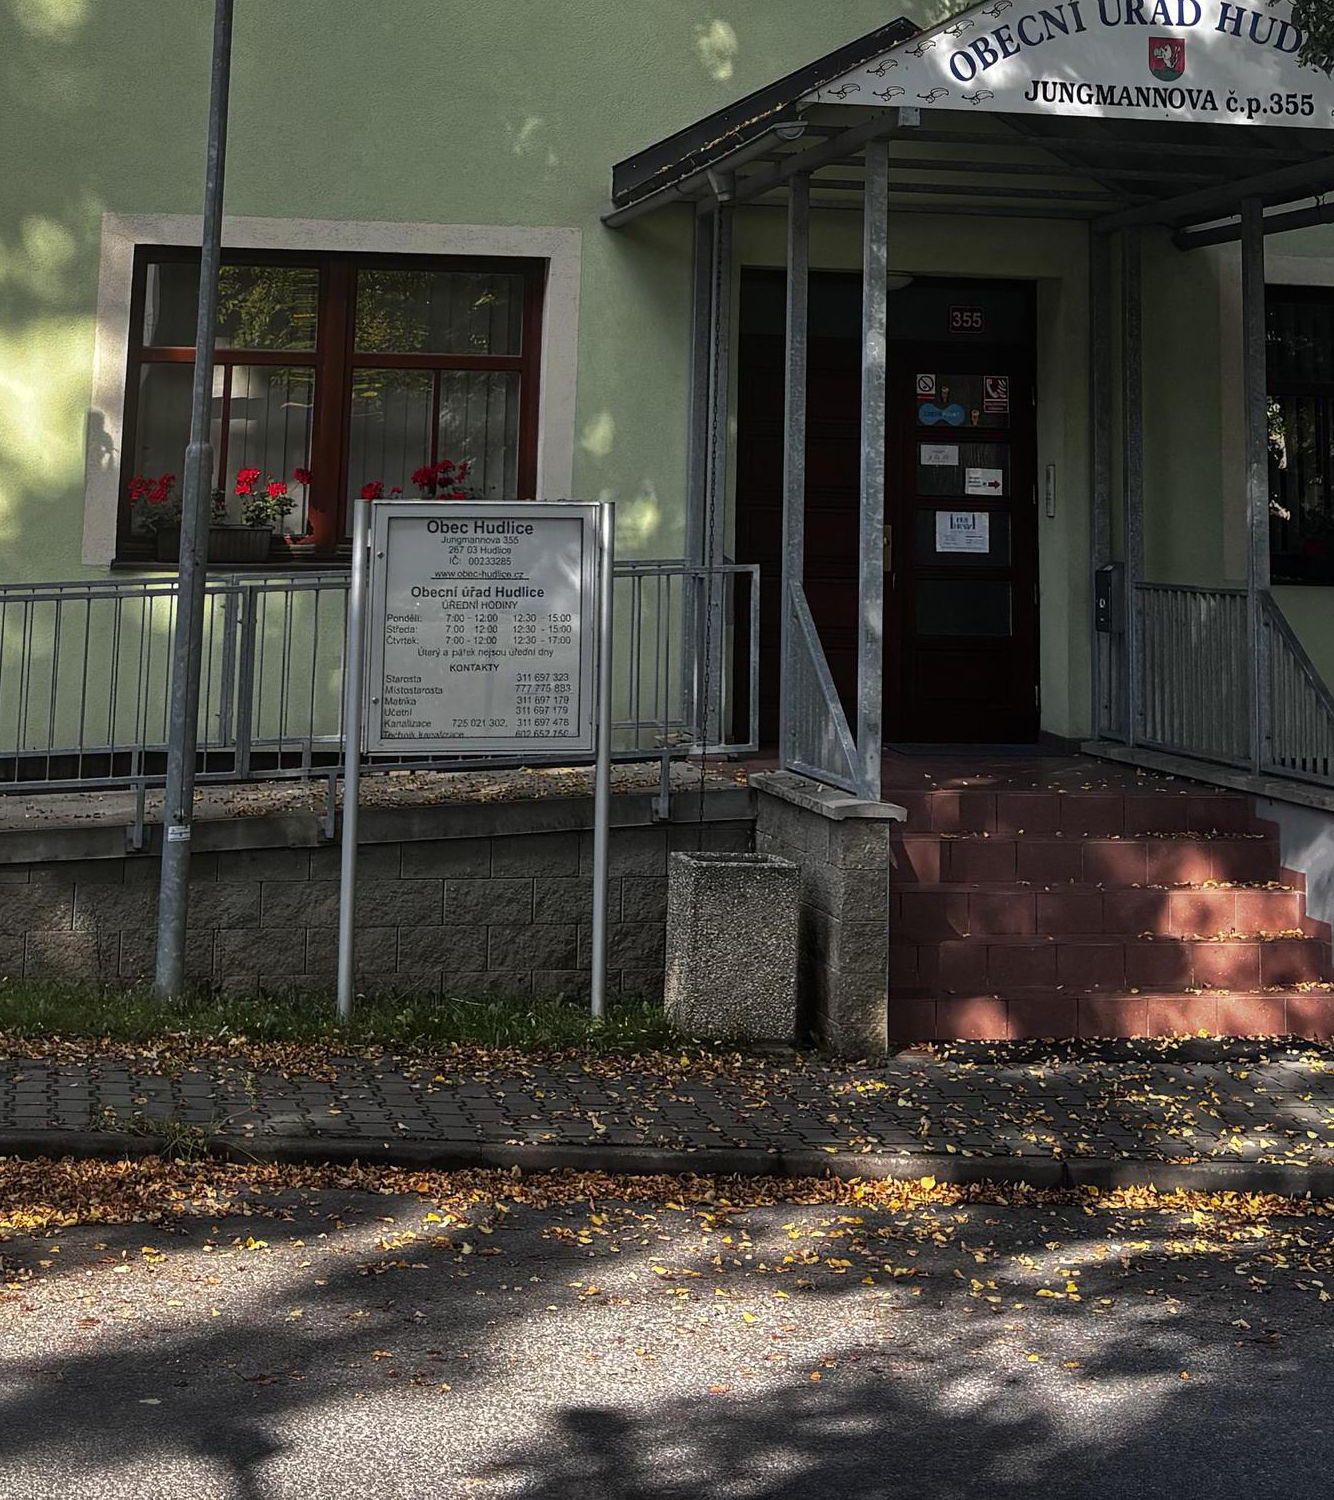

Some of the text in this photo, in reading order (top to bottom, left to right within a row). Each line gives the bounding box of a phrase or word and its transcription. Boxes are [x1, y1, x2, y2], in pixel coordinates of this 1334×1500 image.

[1024, 79, 1315, 119] JUNGMANNOVA č.p.355
[952, 311, 982, 328] 355
[427, 520, 533, 535] Obec Hudlice
[441, 536, 519, 544] Jungmannova 355
[448, 546, 512, 554] 267 03 Hudlice
[468, 557, 512, 565] 00233285
[434, 570, 524, 579] www.obec-hudlice.cz
[411, 586, 545, 598] Obecní úřad Hudlice
[442, 600, 518, 610] ÚŘEDNÍ HODINY
[446, 614, 464, 622] 7:00
[475, 614, 498, 622] 12:00
[513, 614, 536, 622] 12:30
[548, 614, 572, 622] 15:00
[387, 625, 418, 633] Středa:
[475, 625, 498, 633] 12:00
[513, 625, 536, 633] 12:30
[549, 625, 572, 633] 15:00
[474, 636, 497, 644] 12:00
[513, 636, 536, 644] 12:30
[548, 636, 571, 644] 17:00
[478, 648, 506, 657] nejsou
[538, 648, 554, 657] dny
[449, 663, 499, 672] KONTAKTY
[386, 674, 422, 683] Starosta
[516, 673, 531, 682] 311
[553, 673, 569, 682] 323
[515, 684, 532, 693] 777
[516, 696, 531, 705] 311
[515, 706, 531, 715] 311
[384, 719, 431, 728] Kanalizace
[516, 718, 531, 727] 311
